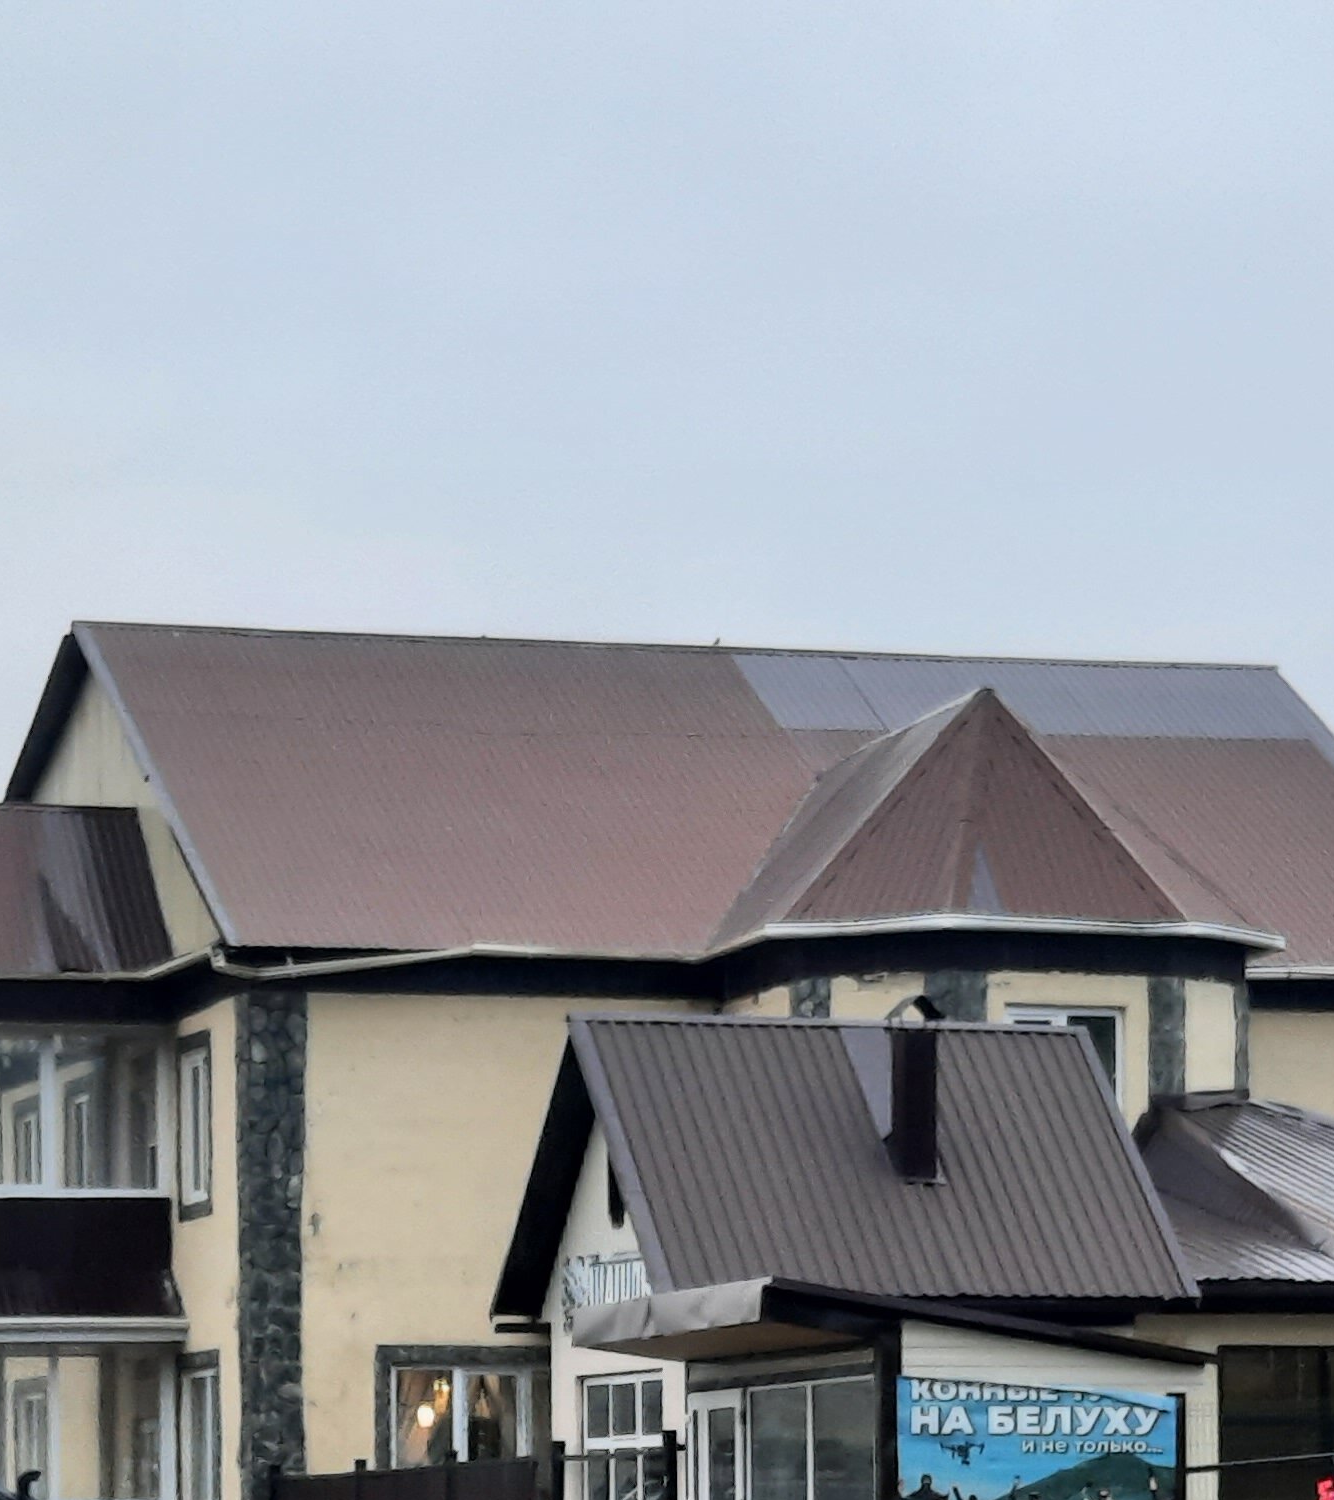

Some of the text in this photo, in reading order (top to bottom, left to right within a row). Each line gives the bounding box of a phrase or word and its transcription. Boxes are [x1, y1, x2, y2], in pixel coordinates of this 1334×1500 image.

[910, 1405, 1160, 1436] НА БЕЛУХУ
[1021, 1440, 1035, 1454] и
[1041, 1440, 1068, 1454] не
